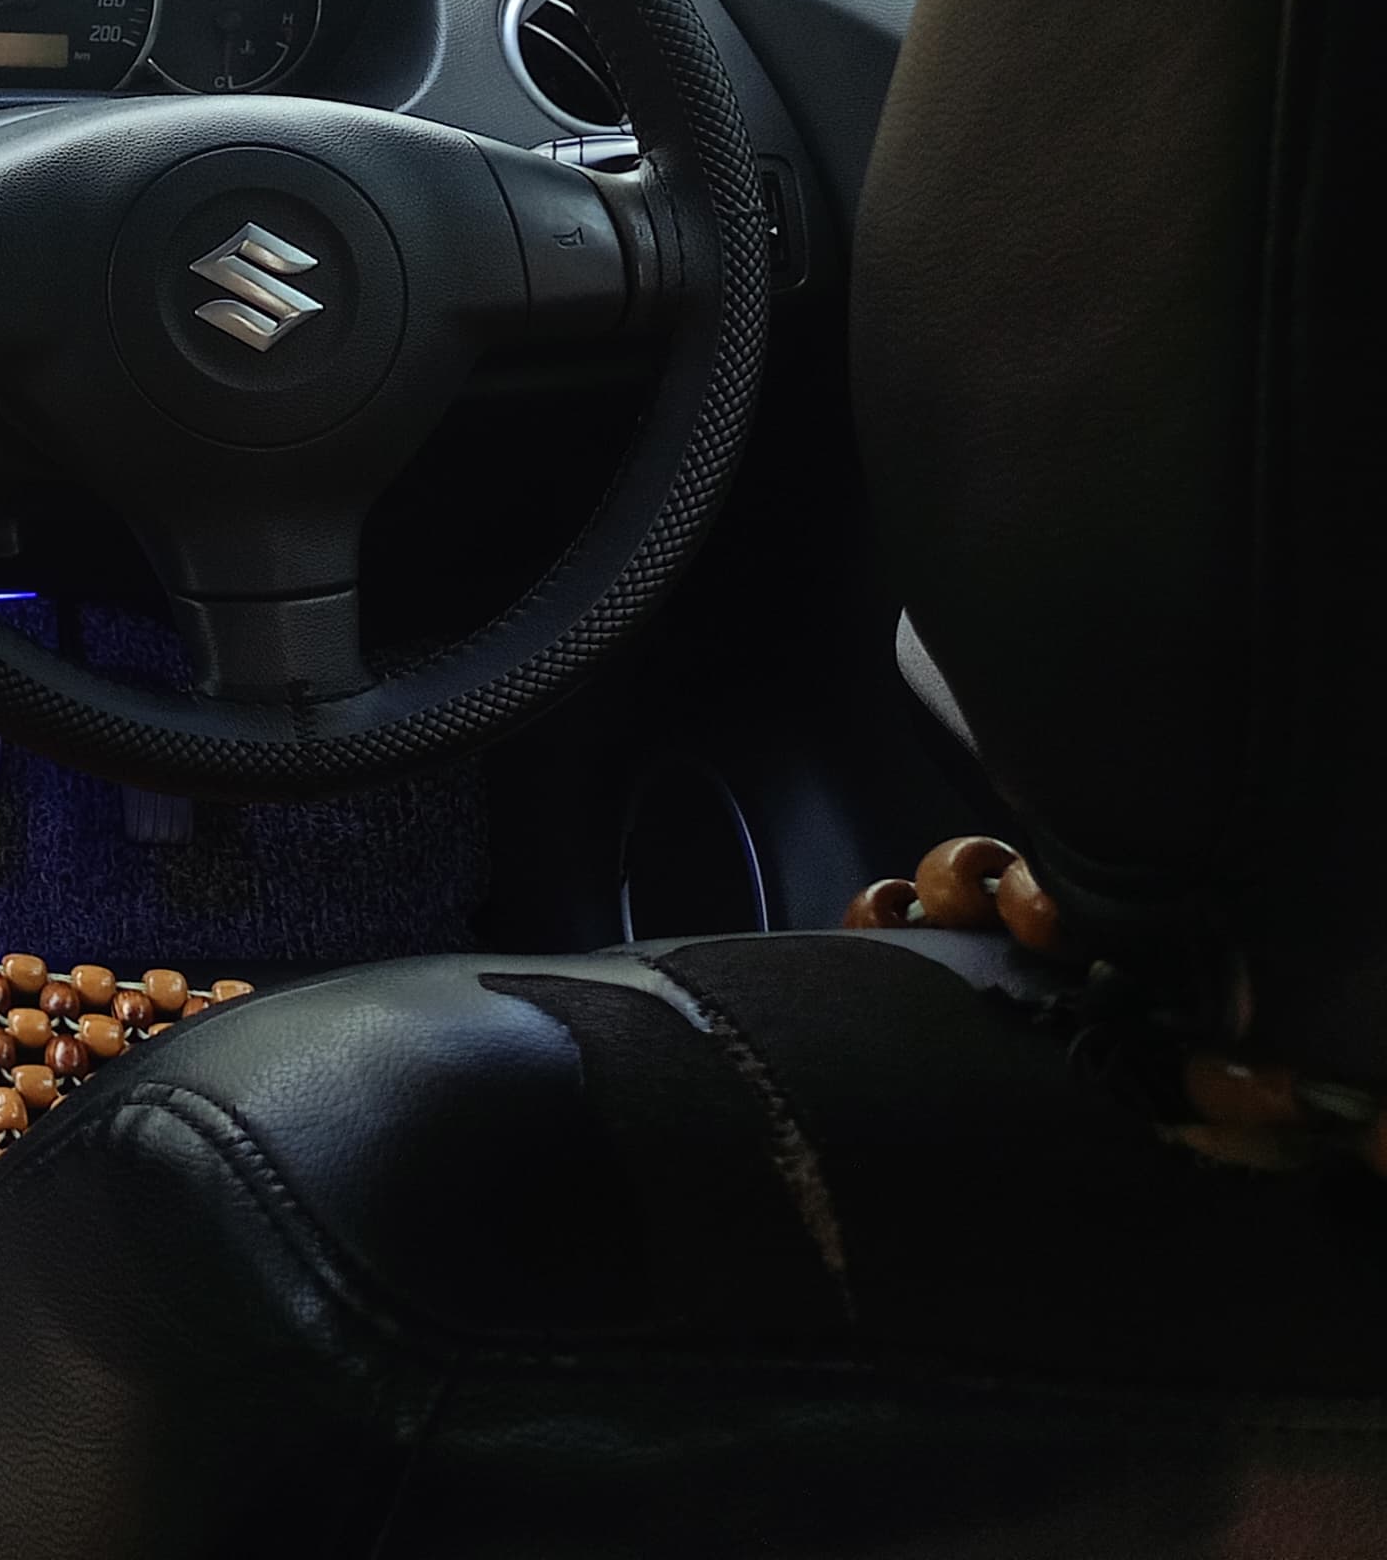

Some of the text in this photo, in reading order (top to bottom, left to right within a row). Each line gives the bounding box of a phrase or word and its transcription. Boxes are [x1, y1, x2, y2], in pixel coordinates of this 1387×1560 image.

[282, 12, 294, 26] H
[89, 25, 122, 43] 200
[213, 75, 225, 89] C
